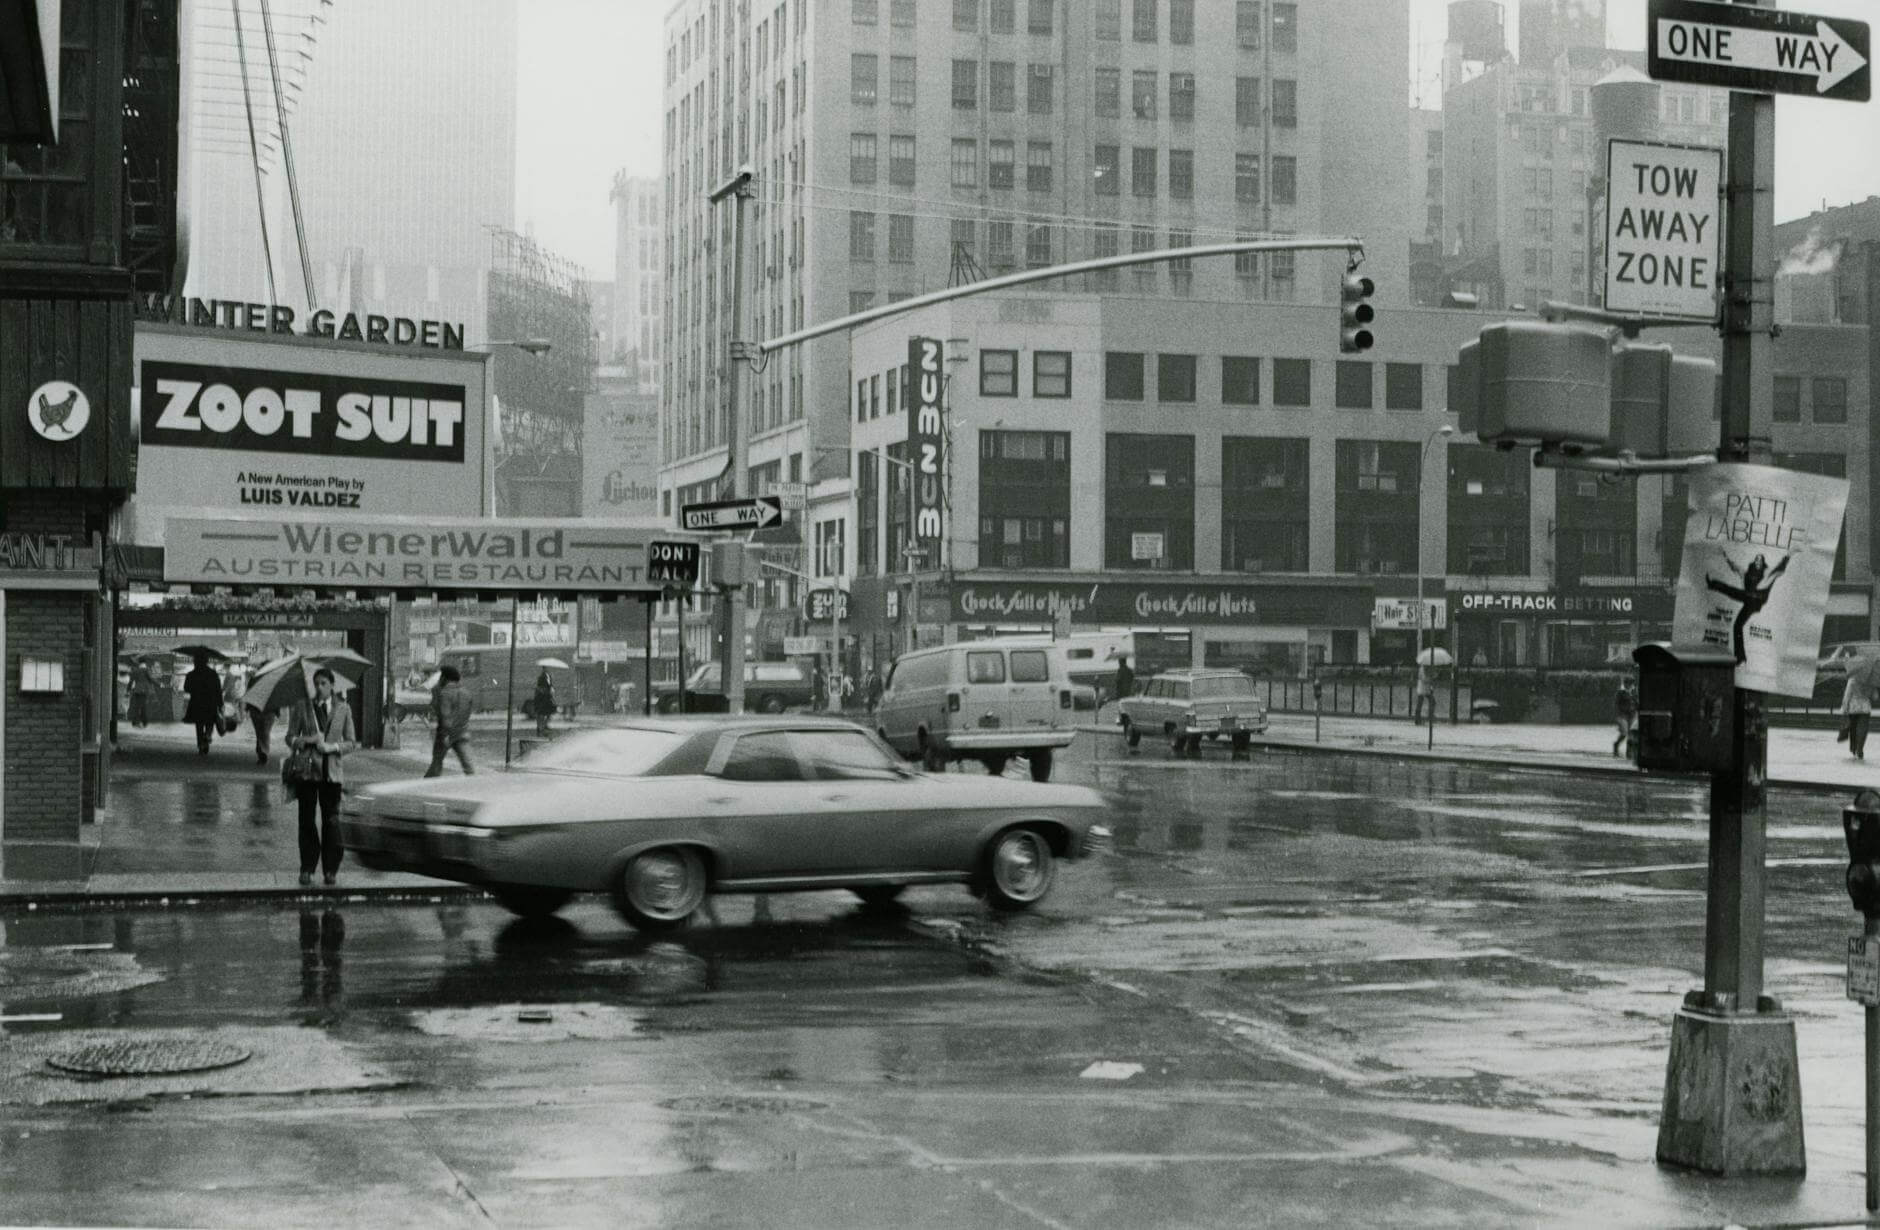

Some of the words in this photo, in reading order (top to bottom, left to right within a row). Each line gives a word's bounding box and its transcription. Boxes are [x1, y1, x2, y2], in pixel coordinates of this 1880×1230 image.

[1668, 24, 1732, 61] ONE
[1776, 37, 1839, 72] WAY
[1633, 163, 1698, 199] TOW
[1615, 207, 1709, 244] AWAY
[1615, 252, 1708, 288] ZONE
[141, 295, 295, 336] WINTER
[309, 309, 464, 350] GARDEN
[156, 379, 321, 438] ZOOT
[335, 392, 462, 446] SUIT
[237, 472, 246, 483] A
[249, 473, 273, 484] New
[275, 473, 326, 488] American
[328, 476, 350, 490] Play
[352, 478, 365, 492] by
[240, 488, 283, 505] LUIS
[287, 490, 361, 508] VALDEZ
[1725, 493, 1787, 523] PATTI
[690, 512, 718, 526] ONE
[737, 507, 766, 521] WAY
[1705, 515, 1806, 550] LABELLE
[0, 534, 72, 568] ANT
[650, 544, 692, 561] DONT
[201, 558, 386, 578] AUSTRIAN
[403, 562, 644, 583] RESTAURANT
[960, 589, 1005, 615] Chock
[1135, 591, 1177, 617] Chock
[1463, 594, 1556, 610] OFF-TRACK
[1564, 597, 1633, 612] BETTING
